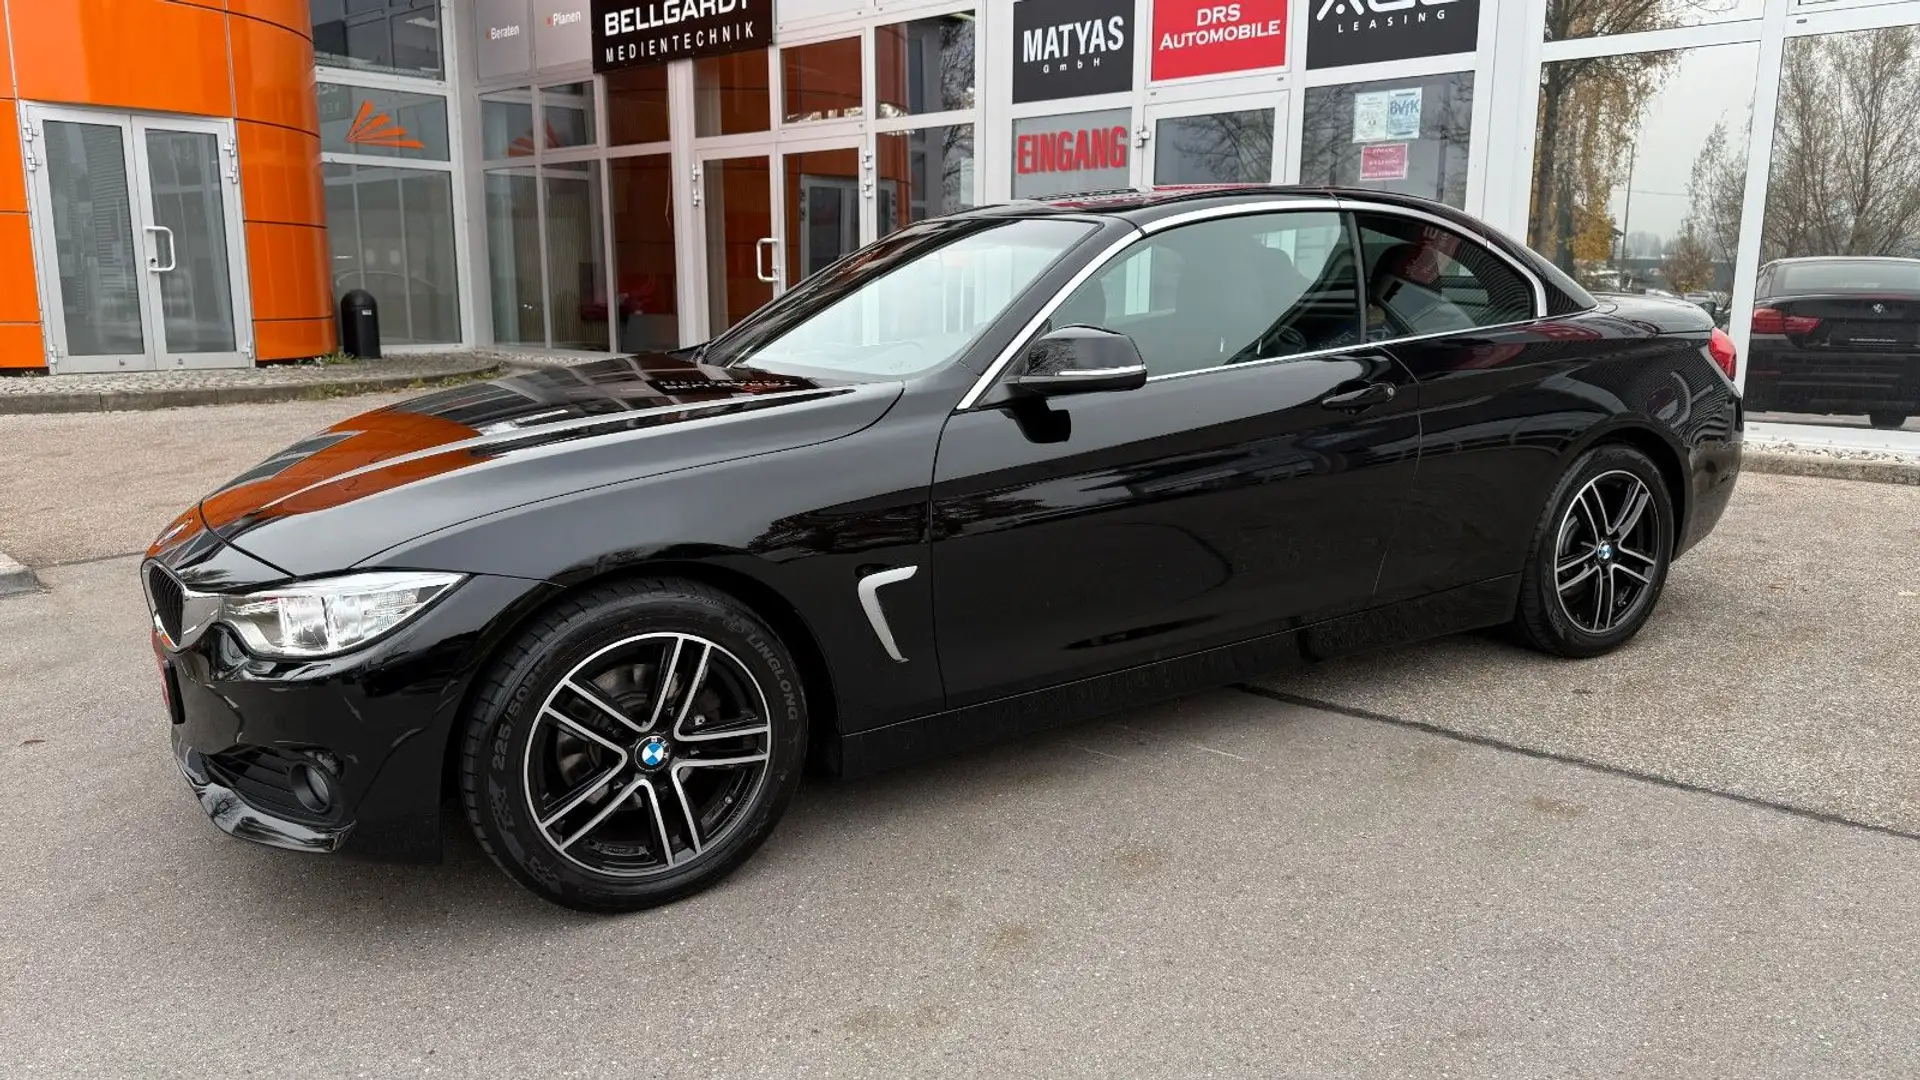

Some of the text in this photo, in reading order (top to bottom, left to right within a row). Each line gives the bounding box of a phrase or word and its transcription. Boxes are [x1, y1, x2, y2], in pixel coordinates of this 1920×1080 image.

[553, 11, 581, 26] Planen
[1196, 3, 1241, 27] DRS
[1337, 9, 1446, 34] LEASING
[490, 25, 520, 40] Beraten
[605, 21, 754, 63] MEDIENTECHNIK
[1023, 15, 1125, 63] MATYAS
[1159, 19, 1281, 51] AUTOMOBILE
[1017, 125, 1128, 176] EINGANG
[746, 633, 798, 720] LINGLONG
